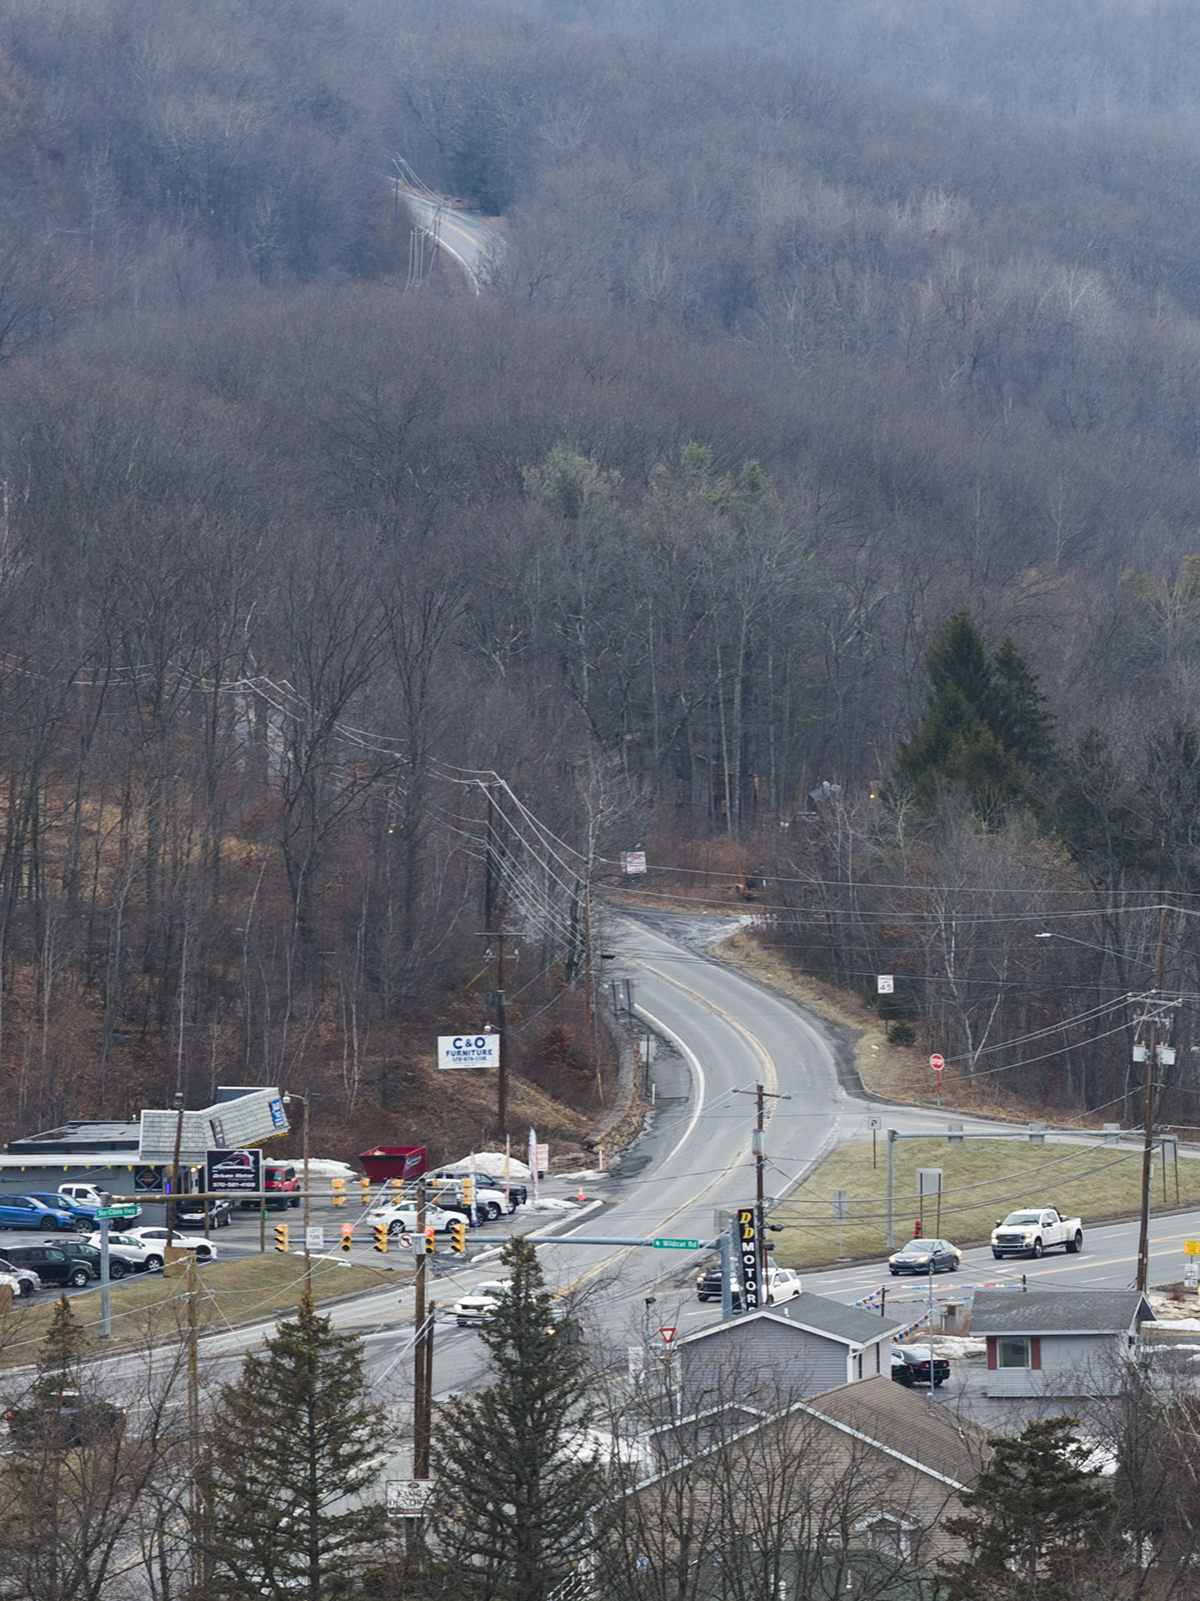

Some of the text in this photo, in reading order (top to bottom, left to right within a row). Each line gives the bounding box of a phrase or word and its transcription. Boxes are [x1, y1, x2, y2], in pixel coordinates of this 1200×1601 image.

[453, 1036, 486, 1050] C & O
[446, 1048, 492, 1056] FURNITURE
